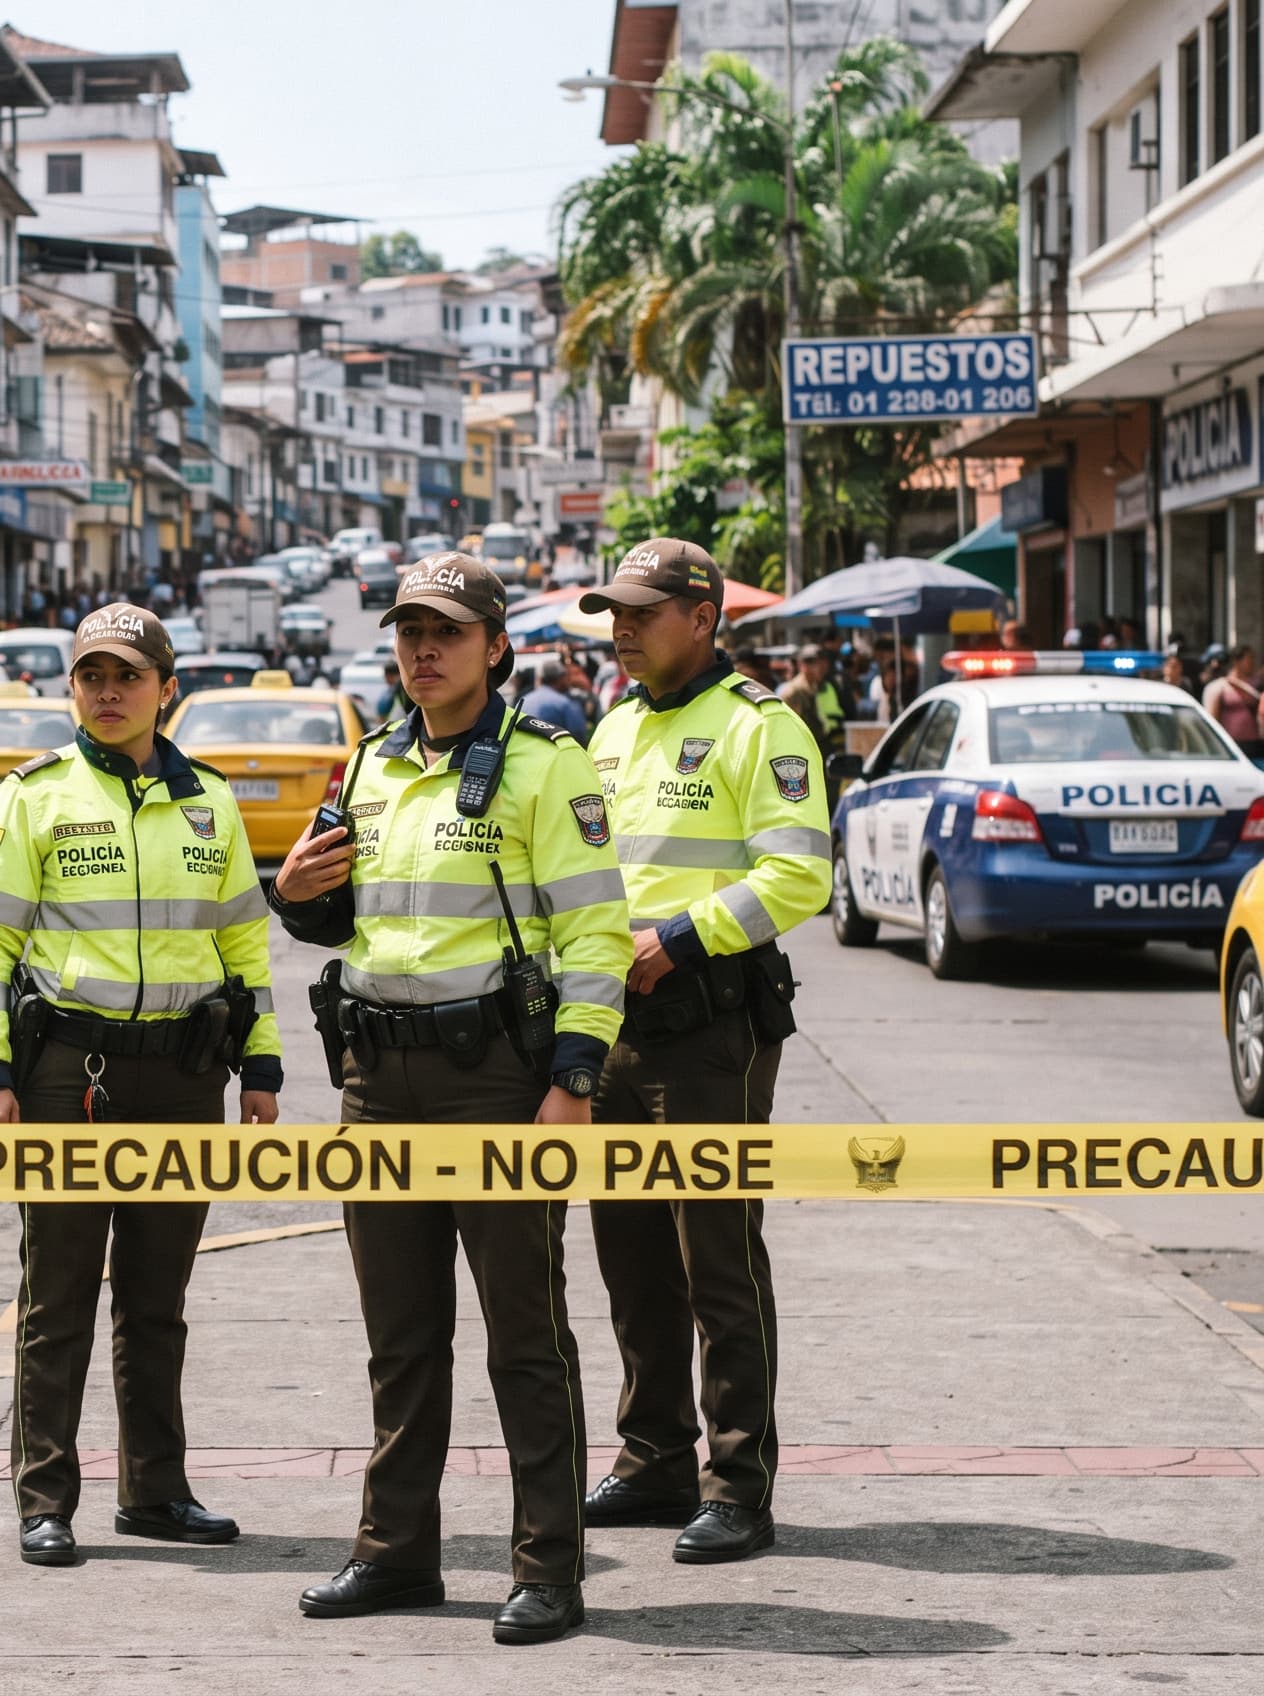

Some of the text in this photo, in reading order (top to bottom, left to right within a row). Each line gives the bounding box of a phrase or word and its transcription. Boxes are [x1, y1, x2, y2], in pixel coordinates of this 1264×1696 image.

[793, 341, 1031, 386] REPUESTOS
[848, 391, 878, 414] 01
[982, 386, 1032, 410] 206
[1062, 778, 1223, 807] POLICÍA
[434, 820, 504, 841] POLICÍA
[57, 841, 126, 865] POLICÍA
[1093, 876, 1225, 909] POLICÍA
[436, 1164, 457, 1176] -
[482, 1138, 578, 1192] NO
[605, 1138, 775, 1192] PASE
[992, 1137, 1264, 1189] PRECAU
